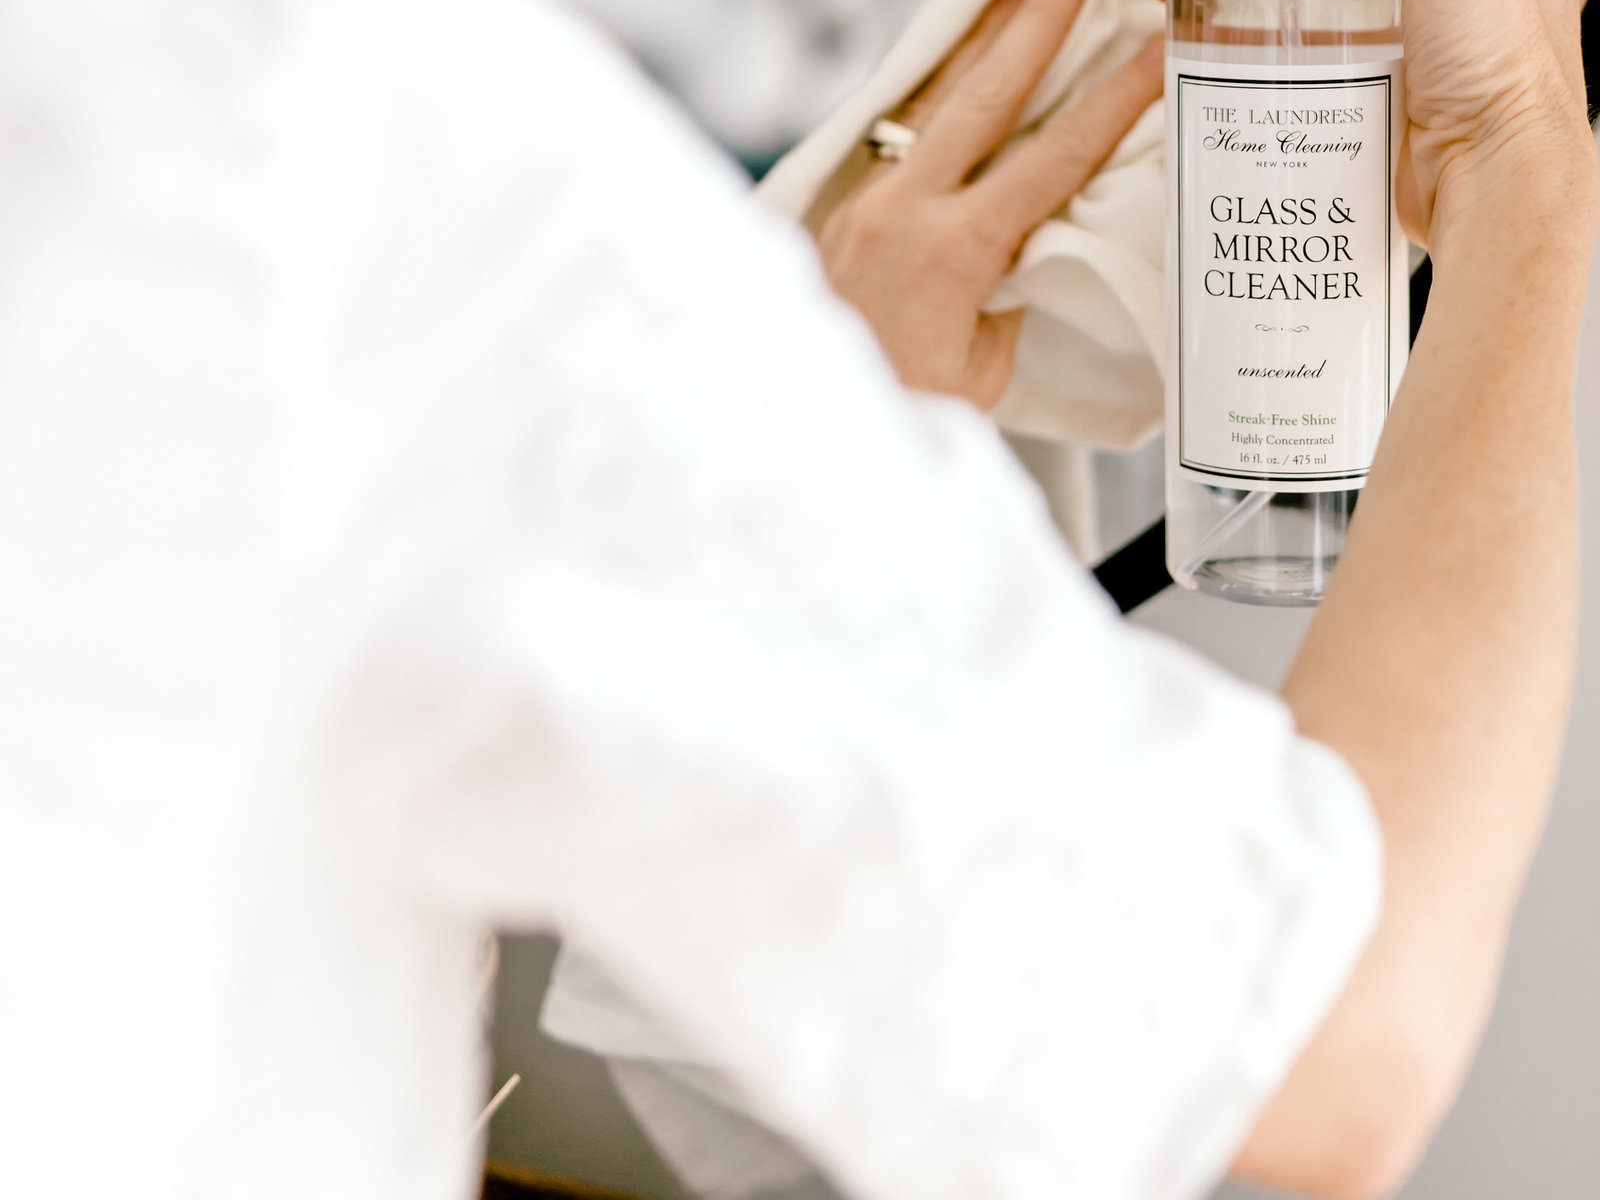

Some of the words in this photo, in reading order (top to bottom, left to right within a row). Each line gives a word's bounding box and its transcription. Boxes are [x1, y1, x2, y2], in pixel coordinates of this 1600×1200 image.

[1203, 106, 1237, 124] THE
[1248, 107, 1364, 126] LAUNDRESS
[1203, 128, 1268, 154] Home
[1276, 130, 1363, 161] Cleaning
[1210, 195, 1317, 226] GLASS
[1328, 195, 1357, 225] &
[1213, 232, 1355, 264] MIRROR
[1203, 269, 1363, 301] CLEANER
[1237, 359, 1328, 379] unscented
[1228, 411, 1298, 426] Streak-Free
[1302, 413, 1337, 426] Shine
[1231, 432, 1263, 446] Highly
[1266, 434, 1334, 446] Concentrated
[1240, 453, 1250, 463] 16
[1253, 453, 1263, 464] fl.
[1266, 456, 1280, 465] oz.
[1282, 454, 1290, 466] /
[1292, 455, 1311, 465] 475
[1314, 454, 1327, 465] ml
